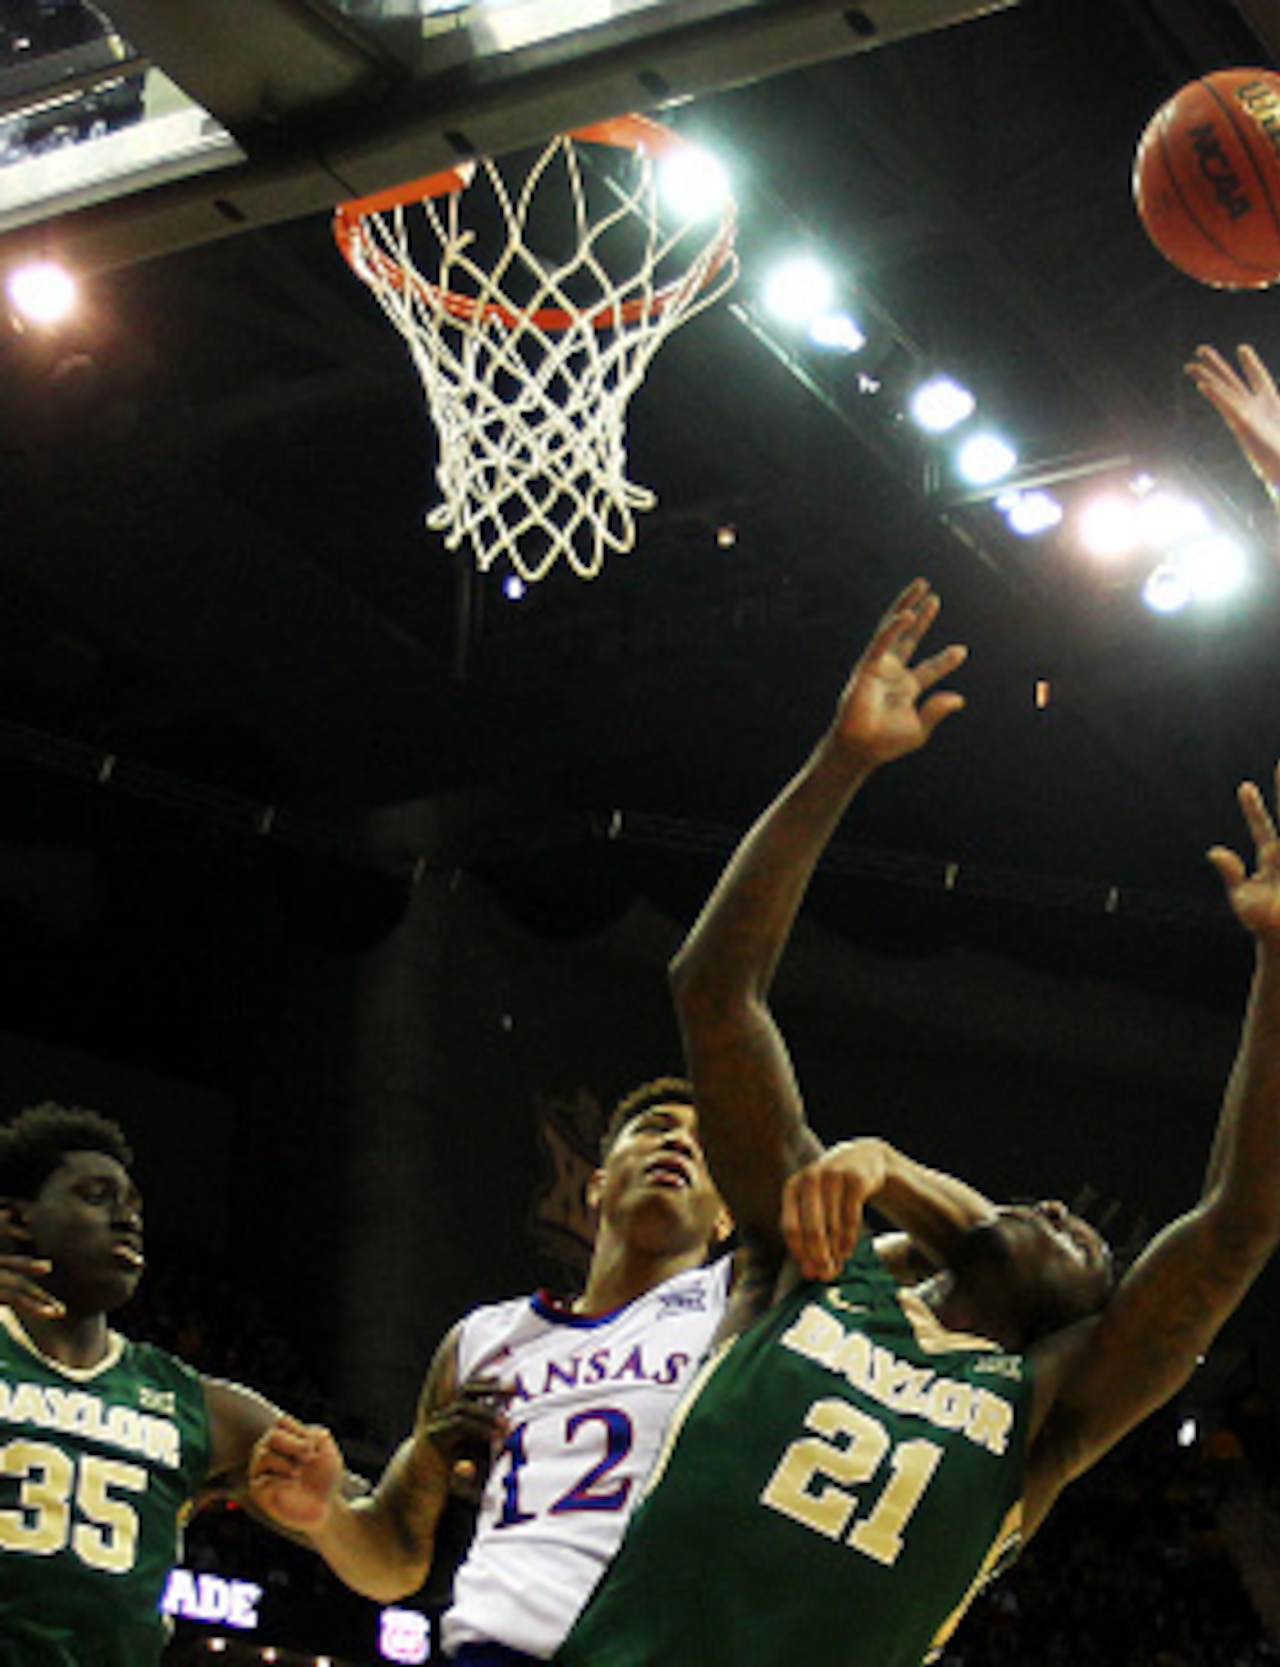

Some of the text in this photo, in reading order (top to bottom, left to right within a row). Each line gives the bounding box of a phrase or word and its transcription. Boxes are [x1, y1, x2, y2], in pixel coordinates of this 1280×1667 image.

[1190, 123, 1251, 218] NCAA
[505, 1345, 690, 1410] ANSAS
[781, 1304, 1014, 1456] BAYLOR
[0, 1439, 148, 1574] 35
[493, 1408, 634, 1529] 12
[760, 1399, 944, 1567] 21
[160, 1567, 263, 1629] ADE
